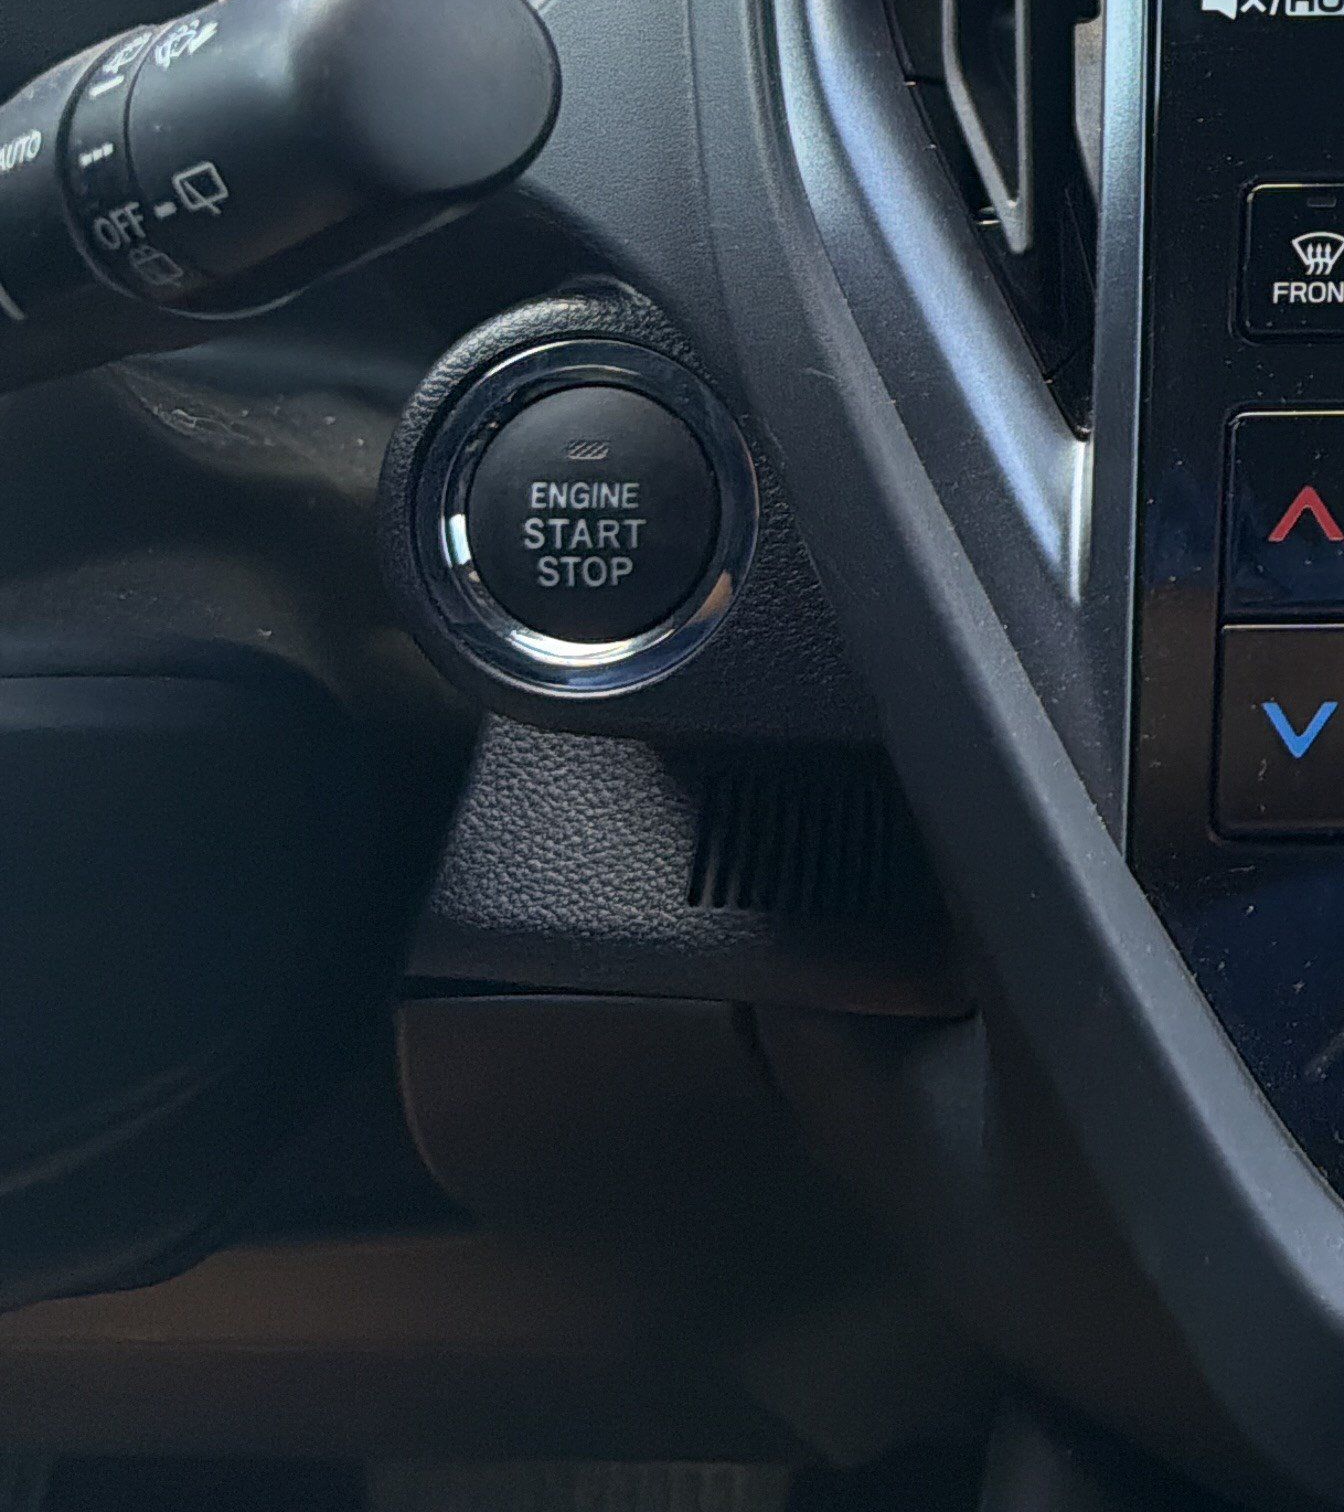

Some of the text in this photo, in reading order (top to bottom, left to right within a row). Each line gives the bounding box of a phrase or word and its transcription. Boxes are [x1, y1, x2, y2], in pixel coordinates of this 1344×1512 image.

[0, 129, 42, 171] AUTO
[93, 201, 146, 250] OFF
[530, 481, 640, 510] ENGINE
[522, 517, 647, 550] START
[536, 555, 634, 587] STOP
